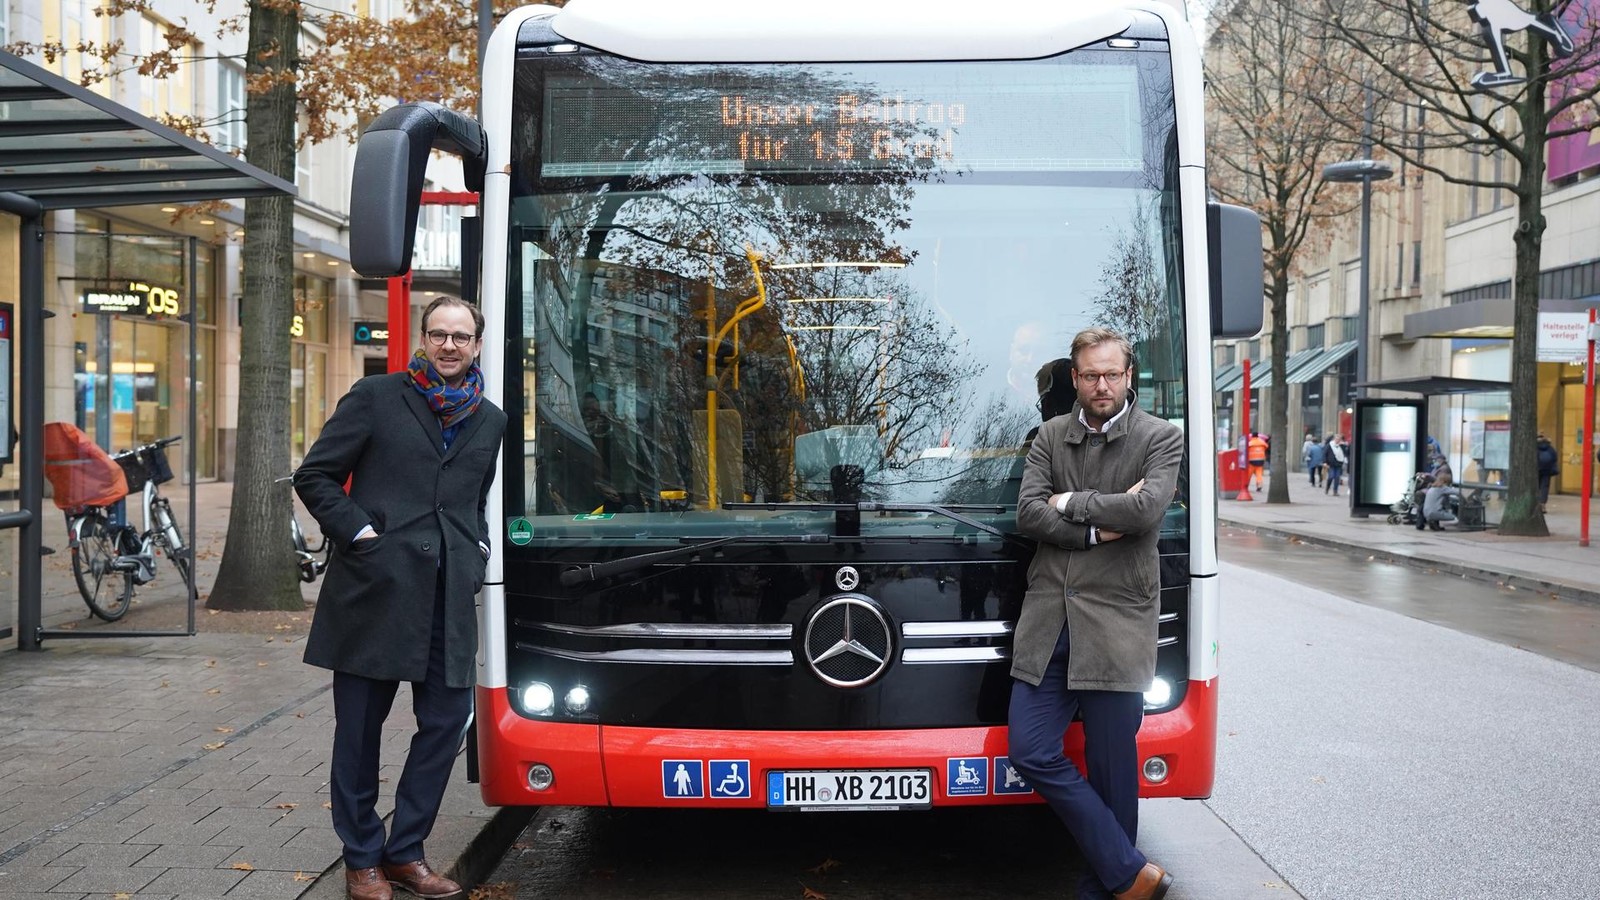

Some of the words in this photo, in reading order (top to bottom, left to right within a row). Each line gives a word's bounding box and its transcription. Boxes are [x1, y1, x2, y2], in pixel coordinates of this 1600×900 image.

[721, 95, 818, 124] Unser
[838, 95, 965, 124] Beitrag
[738, 131, 789, 160] für
[873, 128, 953, 159] Grad
[87, 293, 140, 306] BRAUN
[1551, 332, 1578, 340] verlegt
[517, 520, 525, 532] 4
[773, 791, 780, 799] D
[786, 776, 816, 801] HH
[834, 776, 864, 800] XB
[869, 775, 927, 800] 2103
